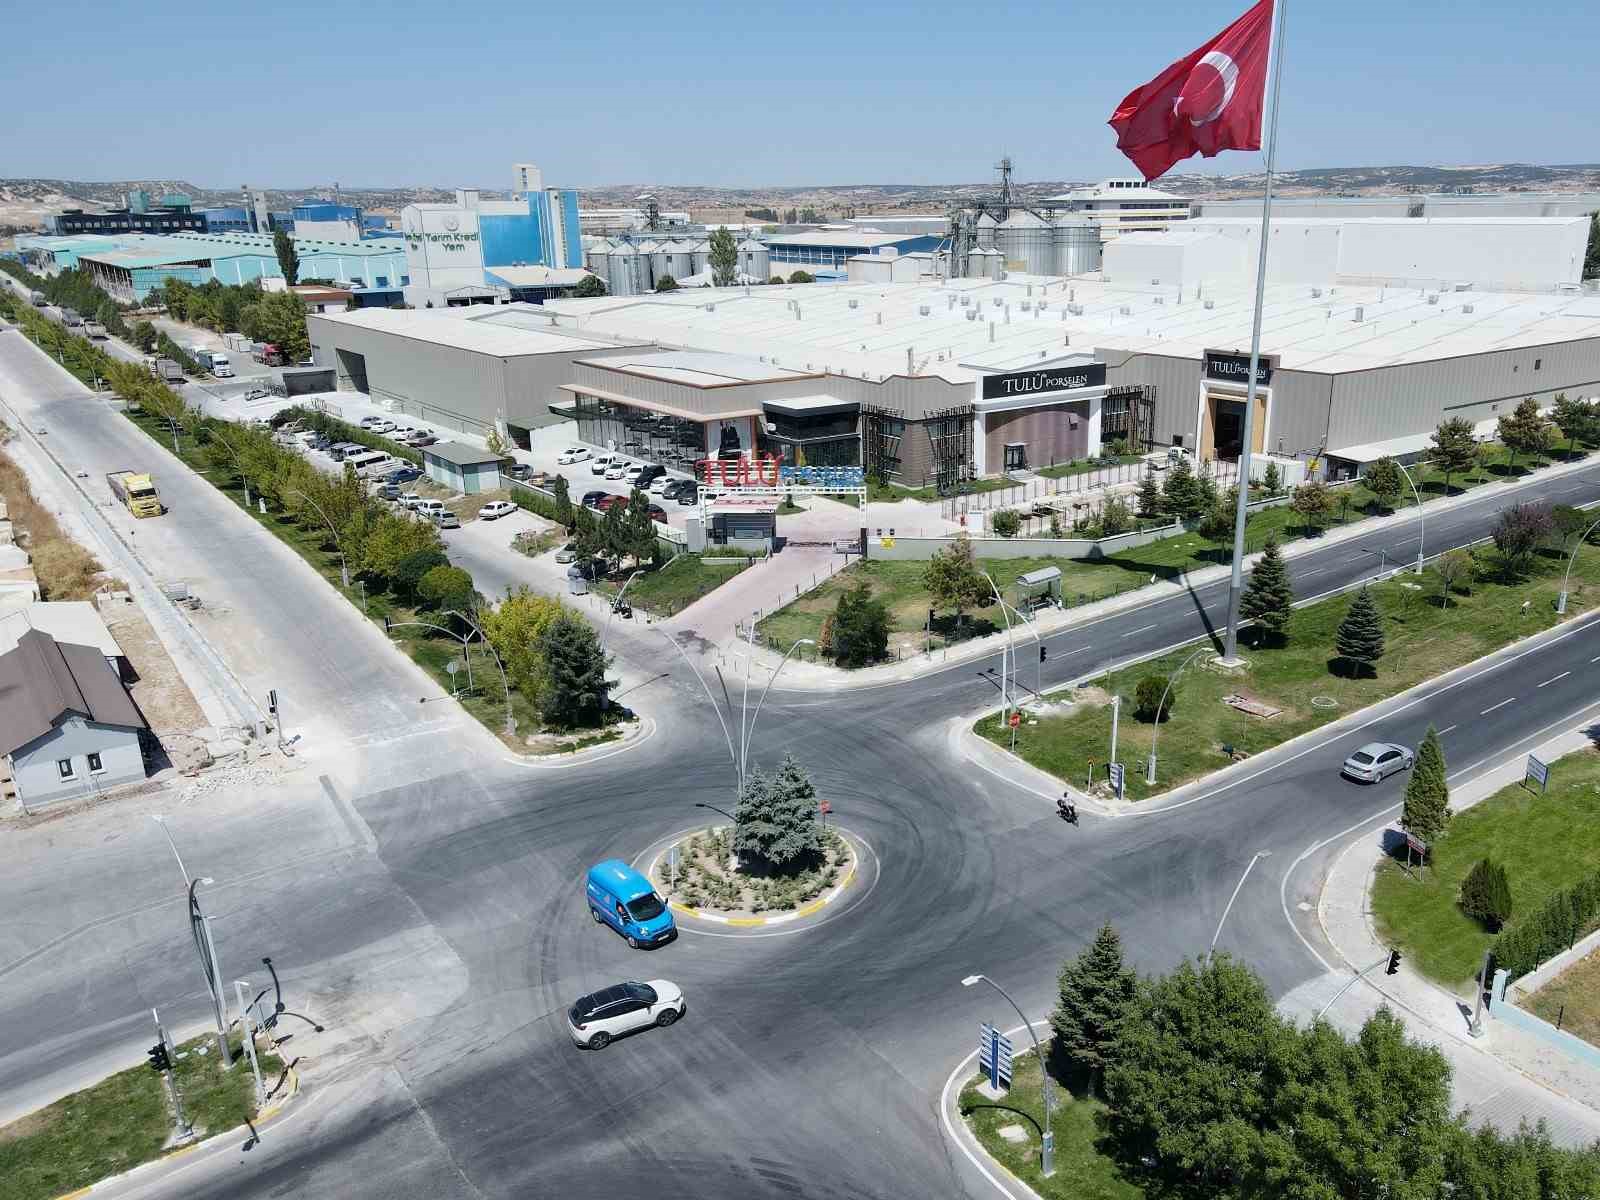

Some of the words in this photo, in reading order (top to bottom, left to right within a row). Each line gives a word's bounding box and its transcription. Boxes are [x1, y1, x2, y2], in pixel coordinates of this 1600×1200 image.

[454, 231, 479, 242] Kredi
[442, 243, 465, 252] Yem
[1046, 374, 1088, 388] PORSELEN
